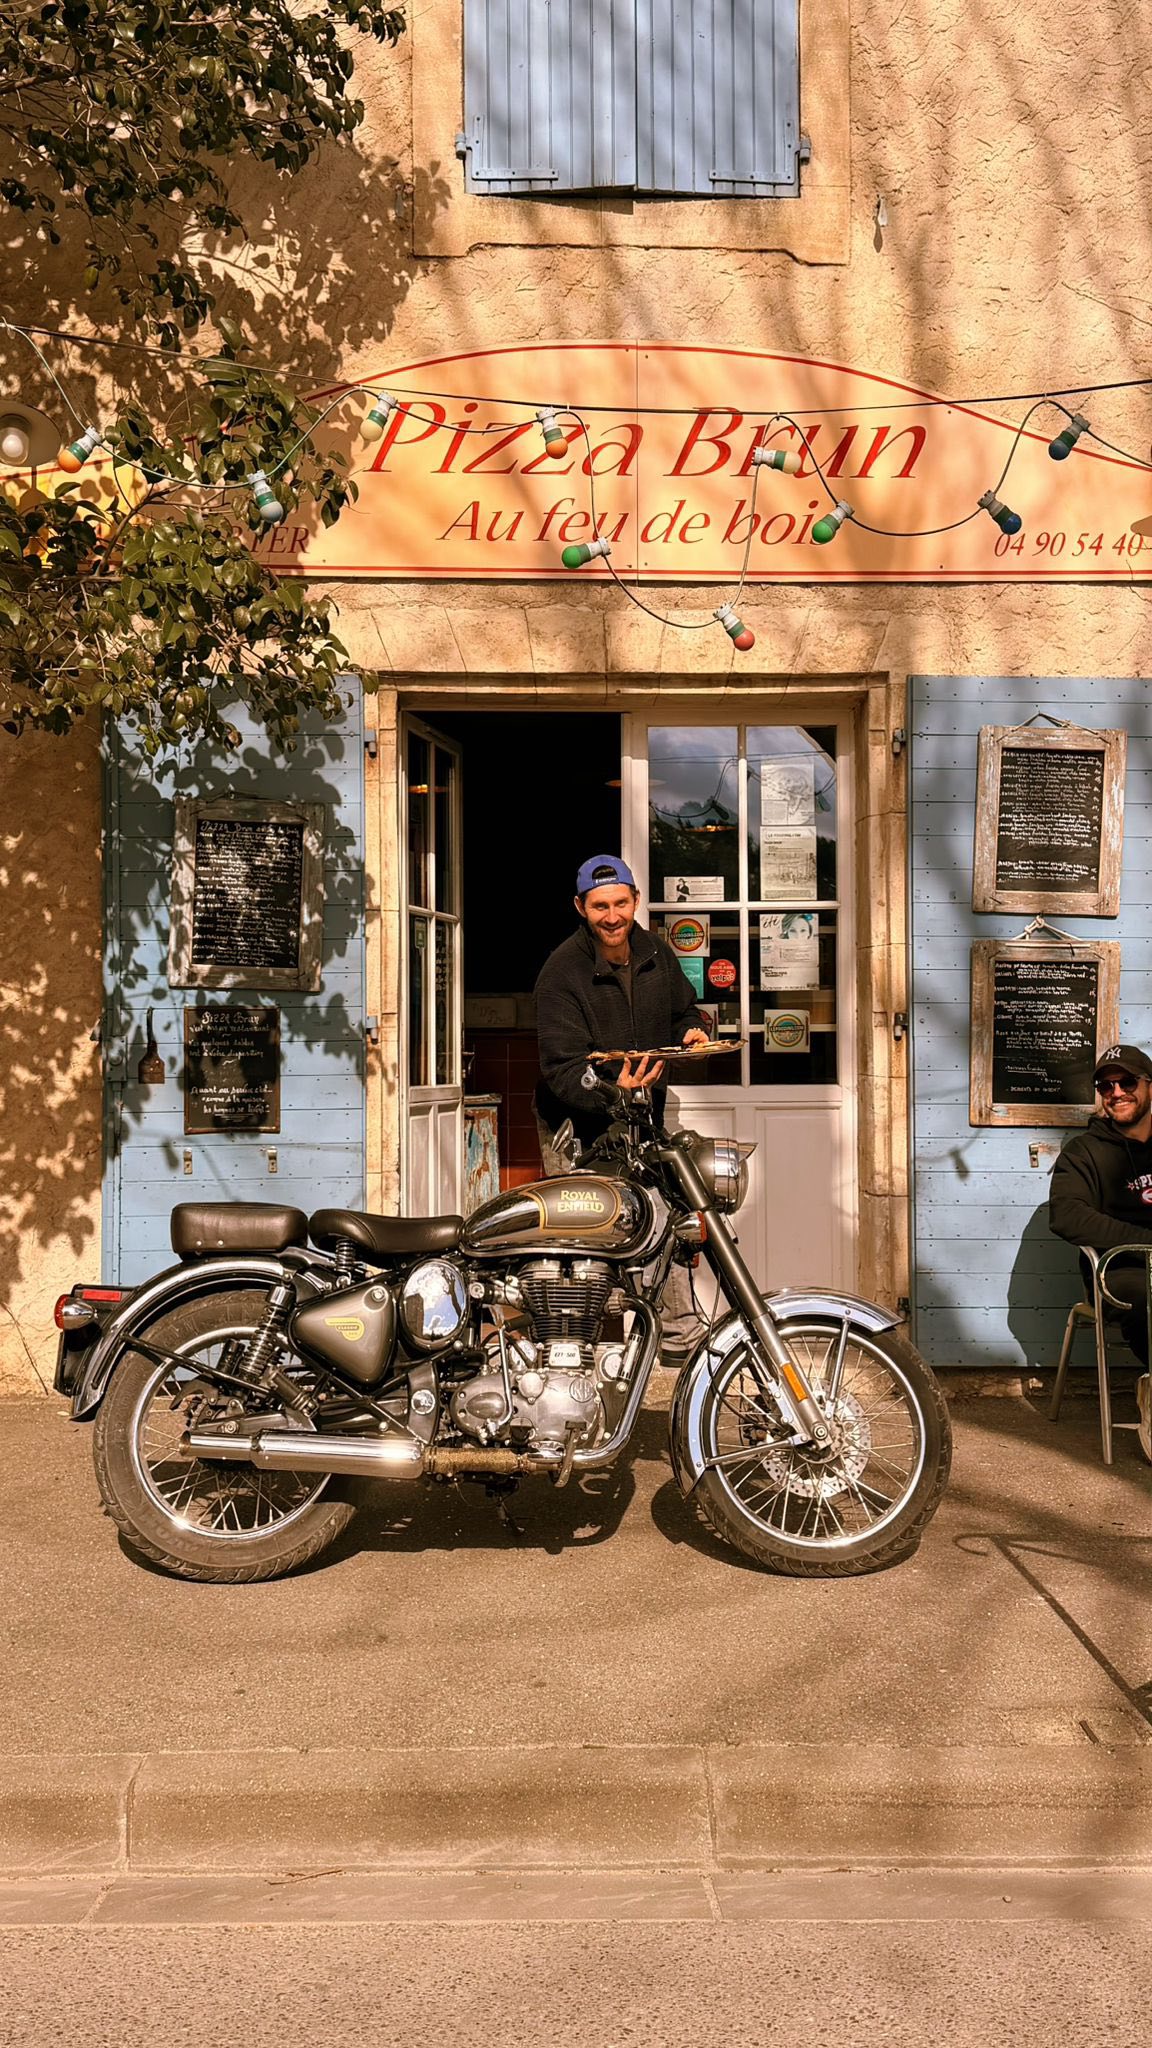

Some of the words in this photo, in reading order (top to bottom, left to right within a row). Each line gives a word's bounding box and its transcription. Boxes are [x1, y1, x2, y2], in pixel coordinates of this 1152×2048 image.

[361, 401, 644, 477] Pizza
[662, 406, 927, 479] Brun
[435, 500, 525, 542] Au
[532, 498, 630, 543] feu
[640, 499, 711, 544] de
[721, 499, 834, 545] boi
[994, 532, 1026, 557] 04
[1032, 532, 1066, 557] 90
[1072, 532, 1104, 557] 54
[1112, 532, 1144, 557] 40
[1105, 1046, 1122, 1060] NY
[561, 1190, 600, 1201] ROYAL
[557, 1201, 605, 1213] ENFIELD
